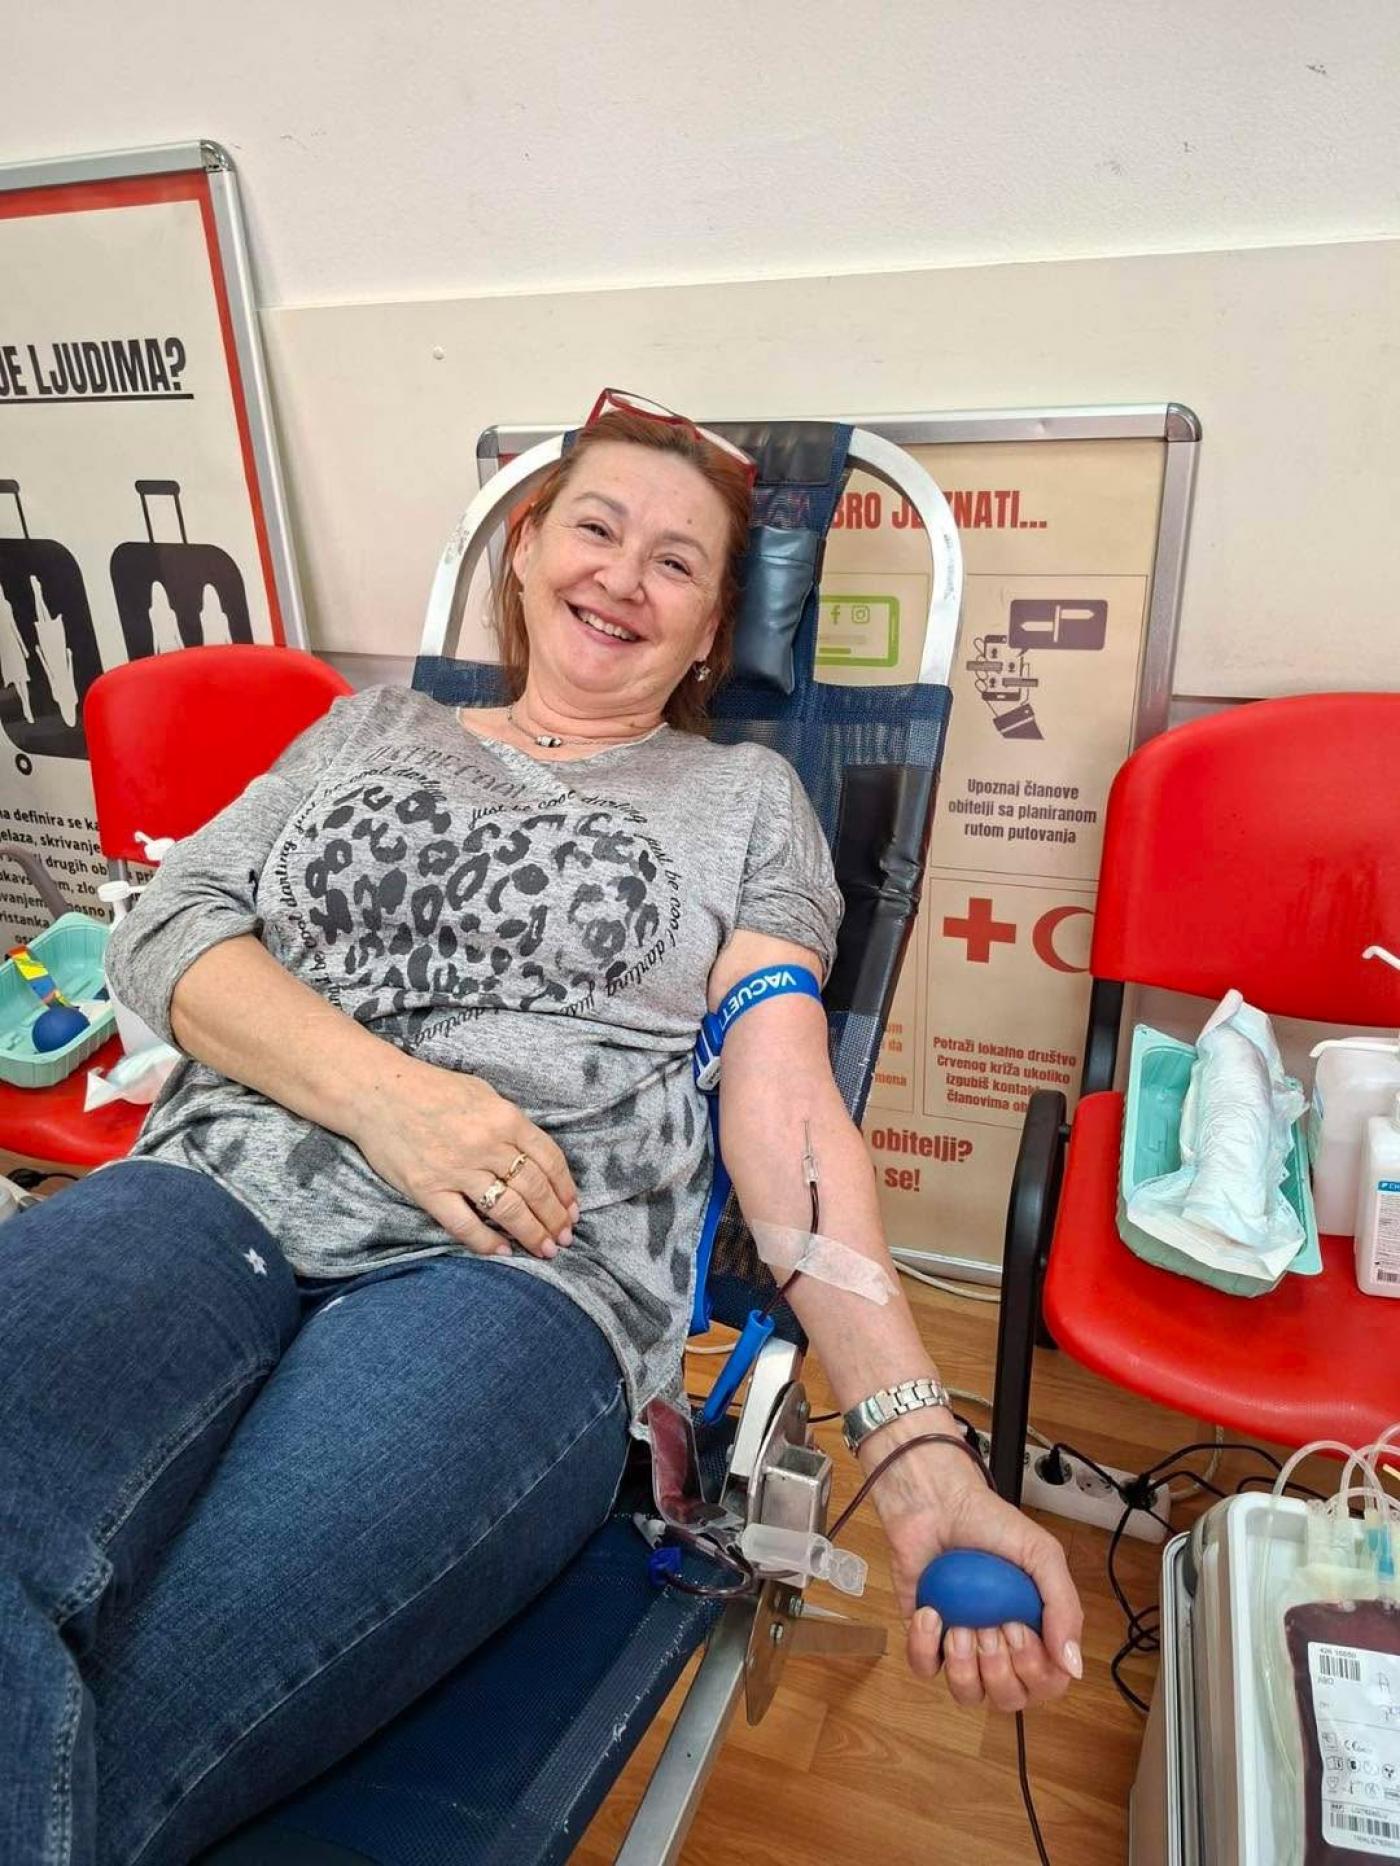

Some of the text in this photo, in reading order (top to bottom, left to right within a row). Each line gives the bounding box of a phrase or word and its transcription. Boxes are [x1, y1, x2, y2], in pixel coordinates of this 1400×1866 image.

[28, 337, 187, 395] LJUDIMA?
[967, 778, 1080, 800] Upoznaj članove
[13, 808, 65, 827] definira
[67, 818, 82, 830] se
[948, 799, 1098, 824] obitelji sa planiranom
[0, 828, 38, 847] elaza,
[964, 822, 1077, 844] rutom putovanja
[46, 855, 88, 875] drugih
[274, 840, 298, 908] darling
[664, 869, 682, 891] be
[665, 896, 681, 947] cool
[604, 938, 666, 998] darling
[932, 1036, 1077, 1068] Potraži lokalno društvo
[936, 1054, 1071, 1085] Crvenog križa ukoliko
[946, 1073, 1038, 1097] izgubiš kontak
[946, 1089, 1009, 1111] članovima
[871, 1128, 973, 1163] obitelji?
[884, 1167, 920, 1193] se!
